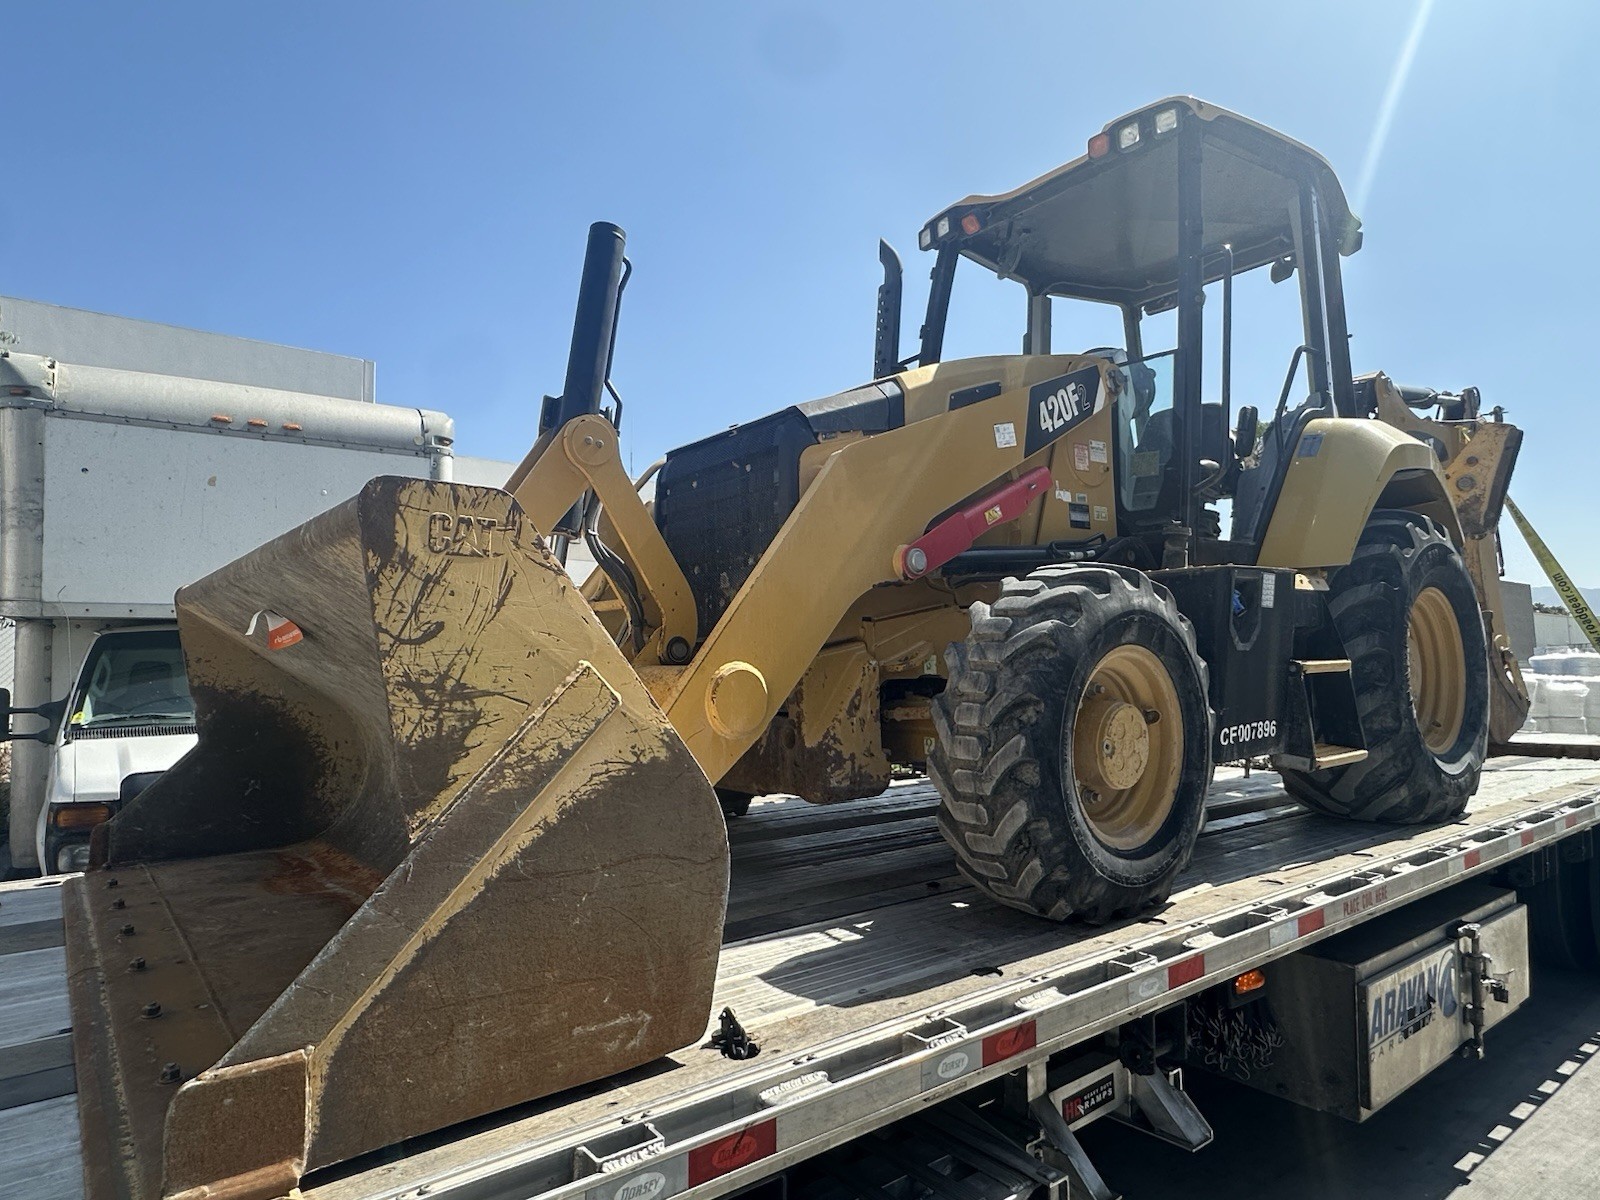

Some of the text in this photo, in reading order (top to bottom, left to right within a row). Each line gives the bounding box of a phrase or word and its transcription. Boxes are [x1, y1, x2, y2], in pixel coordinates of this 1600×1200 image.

[428, 512, 498, 558] CAT
[1220, 720, 1277, 745] CF007896
[1343, 897, 1360, 917] PLACE
[1376, 885, 1388, 903] HERE
[1369, 963, 1438, 1044] ARAVAN
[1369, 1026, 1414, 1062] CARGO
[942, 1057, 966, 1074] DORSEY
[1083, 1088, 1099, 1101] HEAVY
[1084, 1087, 1113, 1110] RAMPS
[620, 1176, 661, 1200] DORSEY
